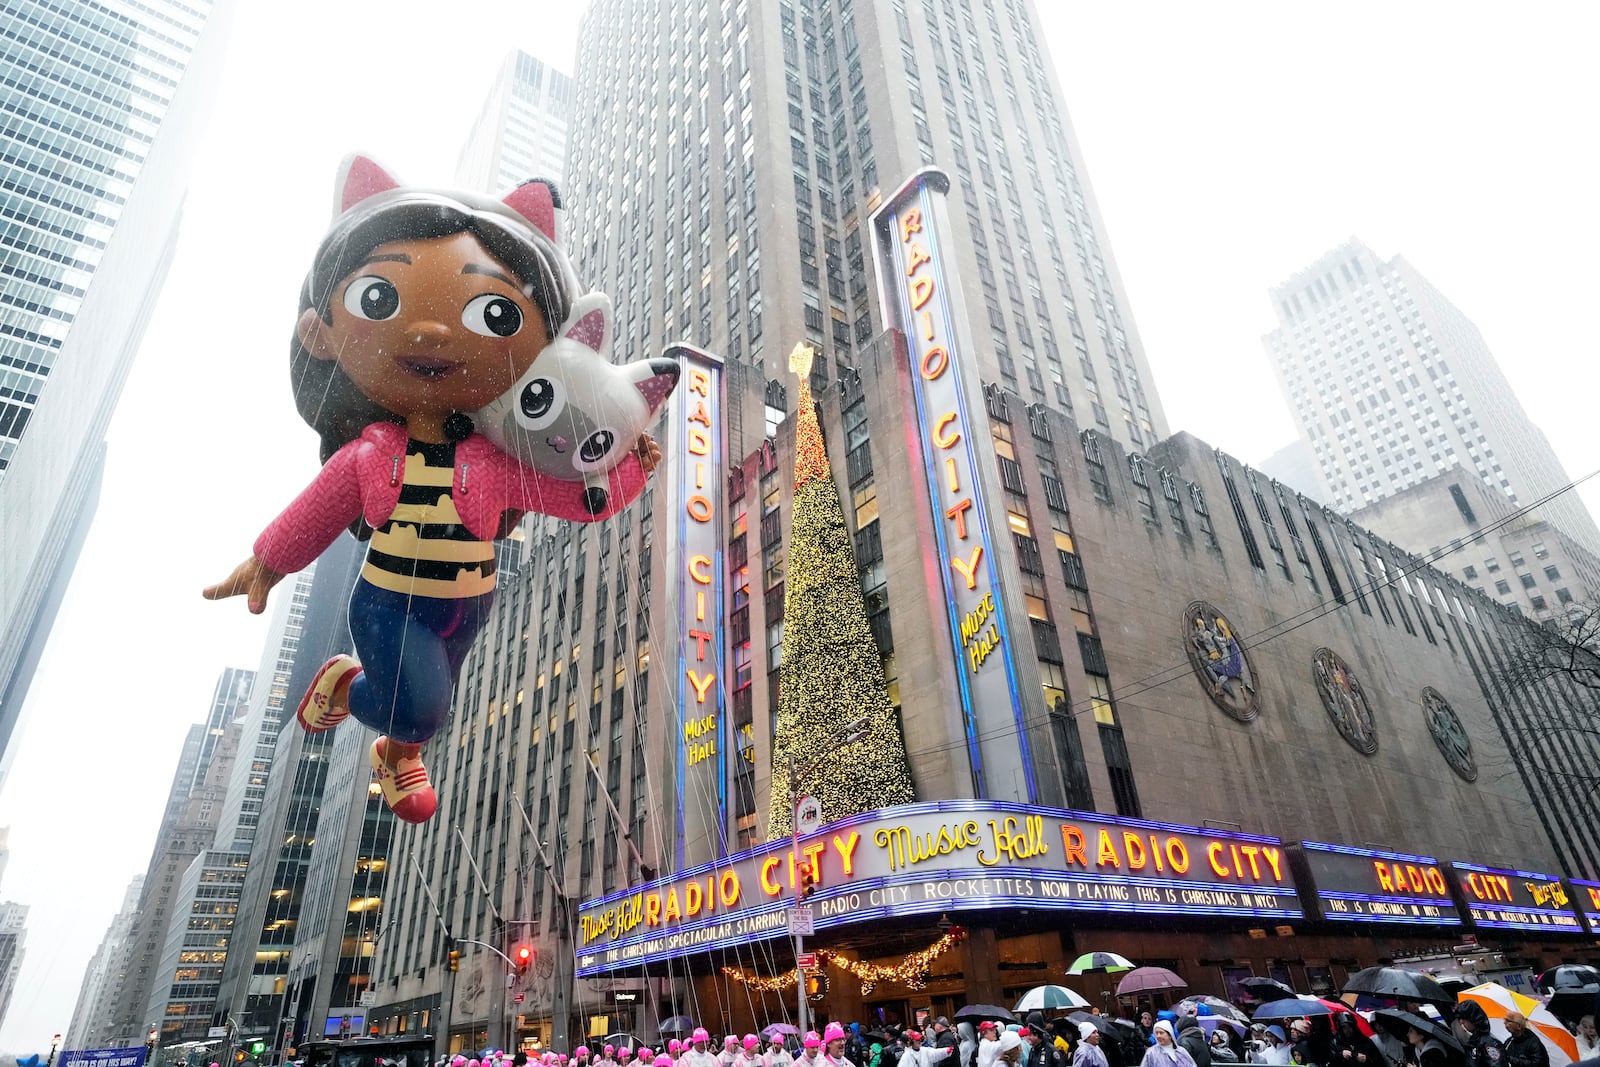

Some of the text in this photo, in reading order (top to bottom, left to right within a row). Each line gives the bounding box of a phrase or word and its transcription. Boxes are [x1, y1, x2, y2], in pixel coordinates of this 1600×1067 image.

[900, 207, 984, 591] RADIO CITY
[687, 369, 715, 703] RADIO CITY
[960, 592, 995, 648] MUSIC
[969, 624, 1000, 673] HALL
[684, 714, 717, 743] MUSIC
[688, 739, 716, 767] HALL
[581, 815, 1283, 945] Music Hall RADIO CITY Music Hall RADIO CITY
[821, 878, 1278, 916] RADIO CITY ROCKETTES NOW PLAYING THIS IS CHRISTMAS IN NYC!
[1374, 861, 1446, 896] RADIO
[1468, 872, 1513, 902] CITY
[1328, 900, 1348, 913] THIS
[1353, 901, 1363, 913] IS
[1368, 902, 1407, 916] CHRISTMAS
[606, 949, 619, 963] THE
[622, 939, 665, 959] CHRISTMAS
[668, 923, 732, 949] SPECTACULAR
[736, 910, 786, 935] STARRING
[97, 1059, 108, 1067] ON
[108, 1058, 120, 1066] HIS
